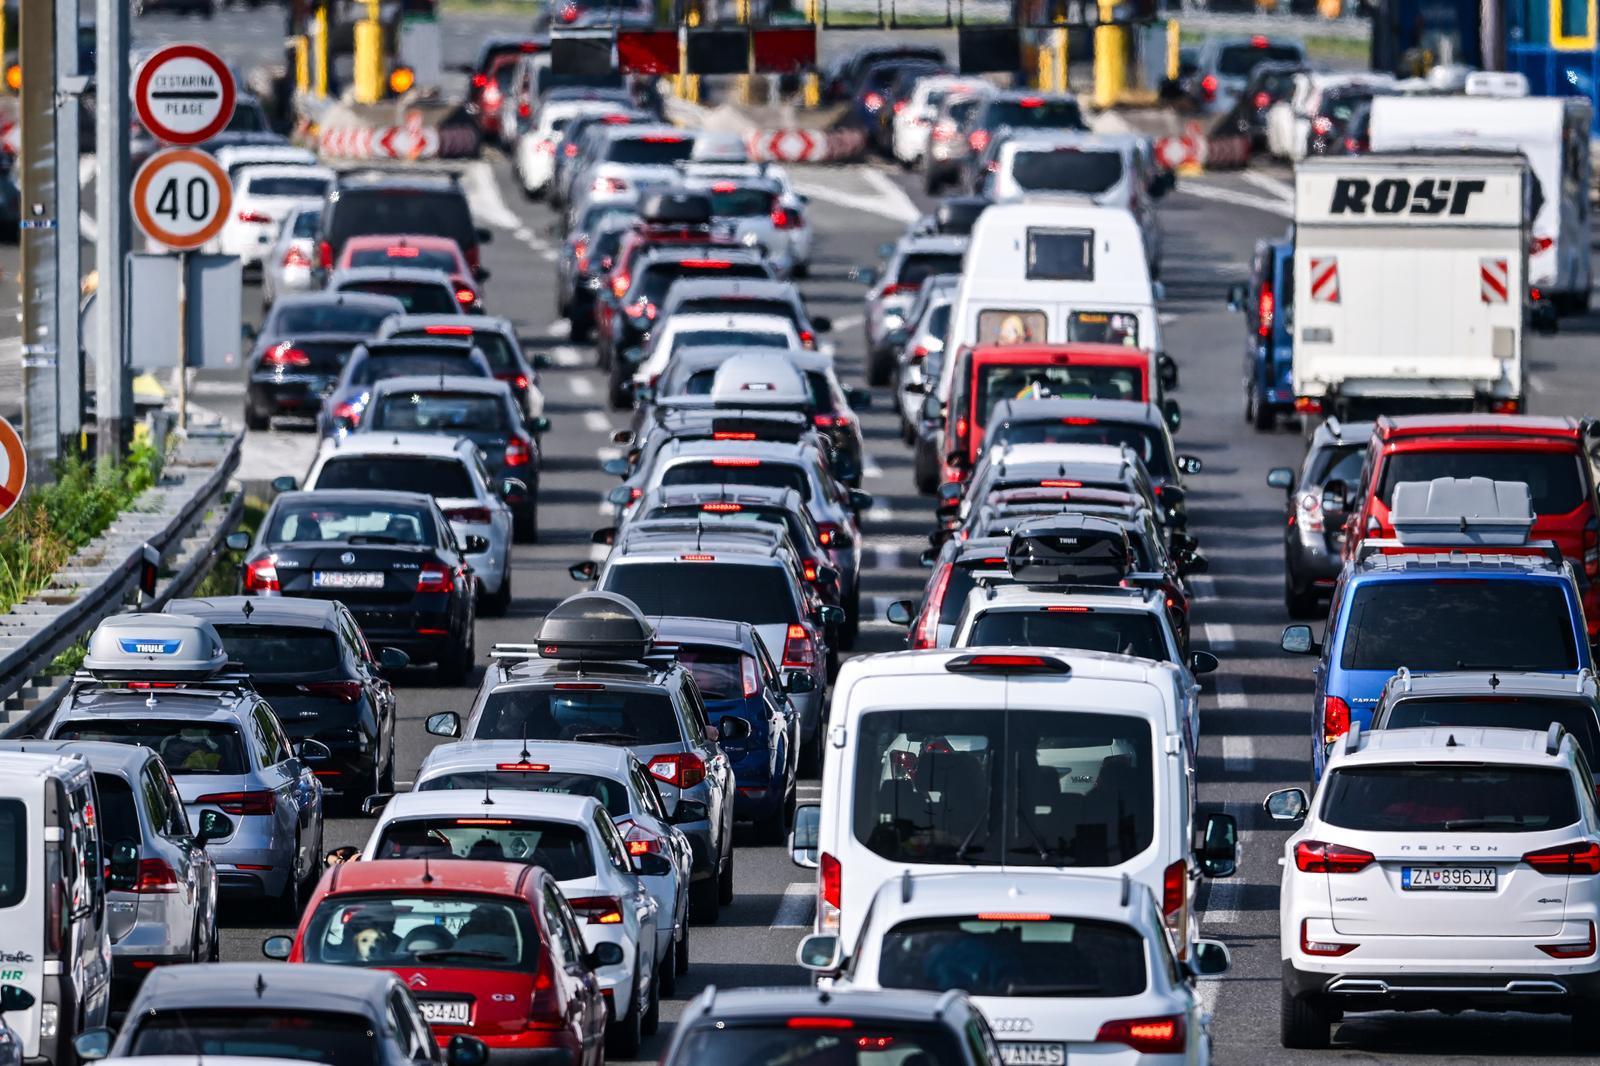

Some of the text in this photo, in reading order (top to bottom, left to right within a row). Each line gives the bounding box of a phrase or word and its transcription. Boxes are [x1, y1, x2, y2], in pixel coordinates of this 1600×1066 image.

[155, 75, 214, 86] CESTARINA
[166, 103, 204, 115] PEAGE
[156, 177, 208, 221] 40
[1330, 179, 1485, 214] ROST
[136, 643, 165, 653] THULE
[1413, 869, 1493, 885] ZA 896JX
[1, 970, 23, 980] HR
[492, 993, 515, 1001] C3
